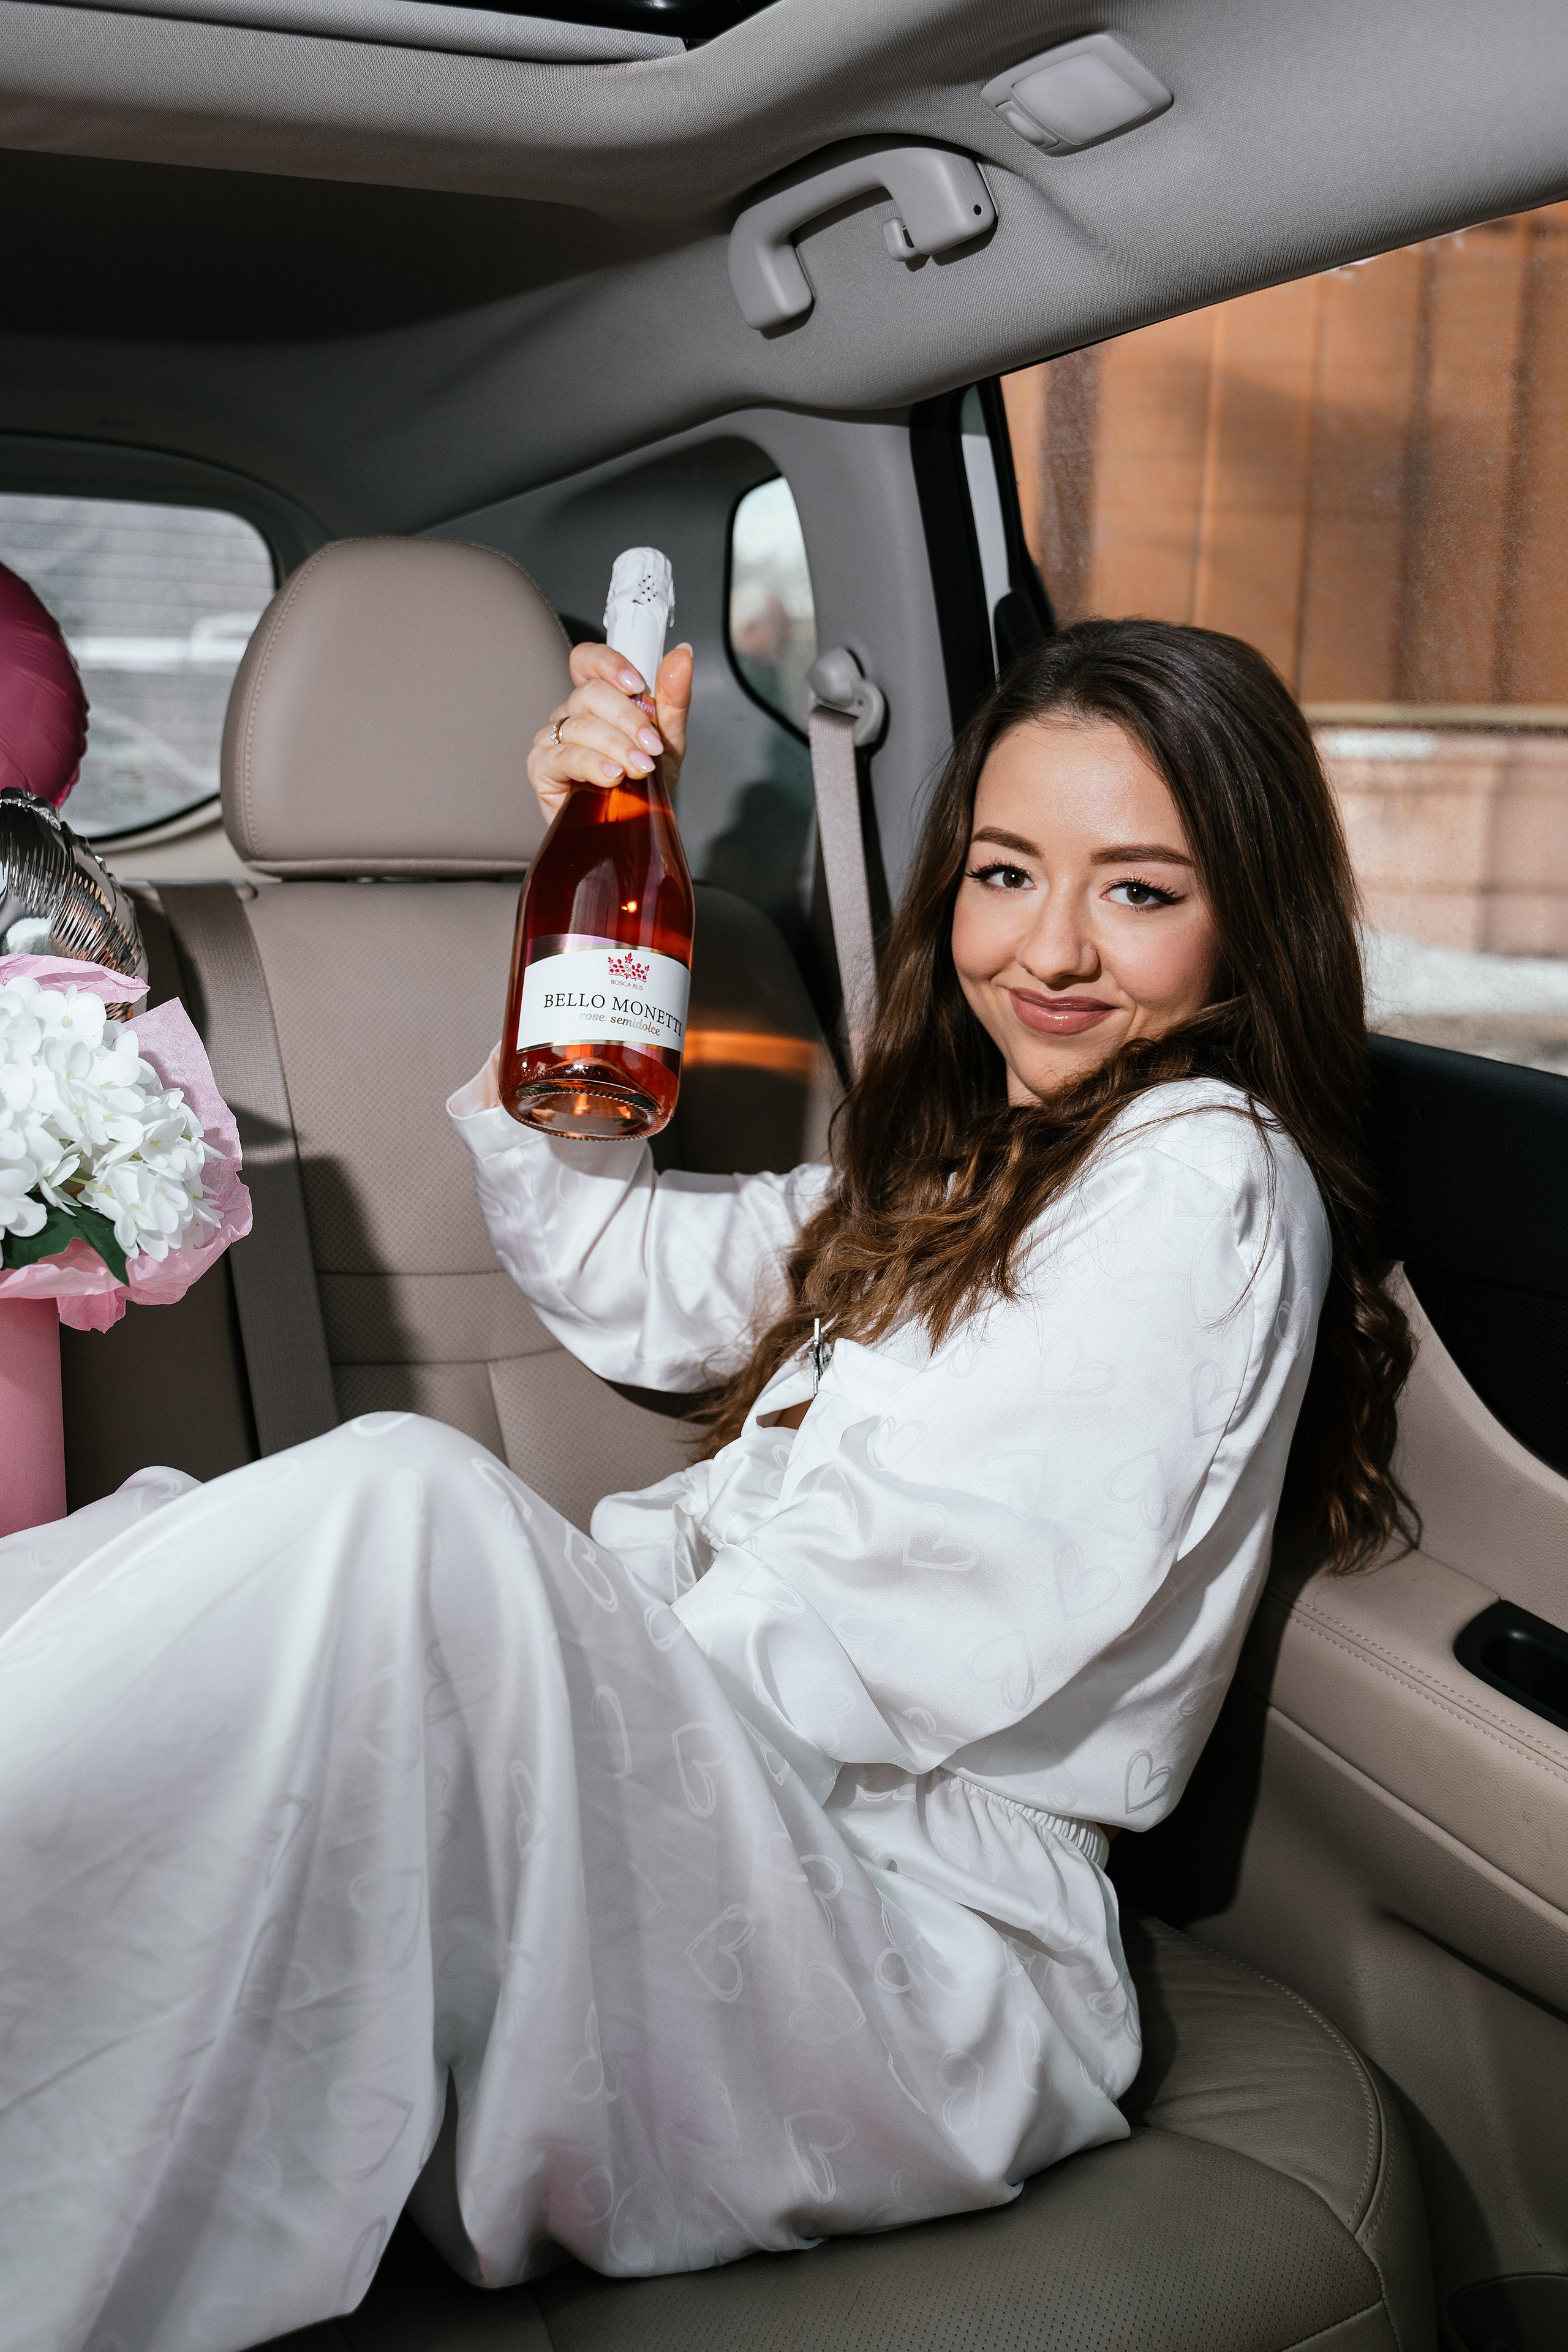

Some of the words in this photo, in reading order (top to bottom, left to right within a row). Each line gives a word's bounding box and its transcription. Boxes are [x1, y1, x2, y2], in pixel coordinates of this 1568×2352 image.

[611, 979, 631, 988] BOSCA
[543, 993, 605, 1008] BELLO
[611, 997, 682, 1037] MONETTI
[579, 1012, 606, 1022] rose
[610, 1014, 660, 1036] semidolce
